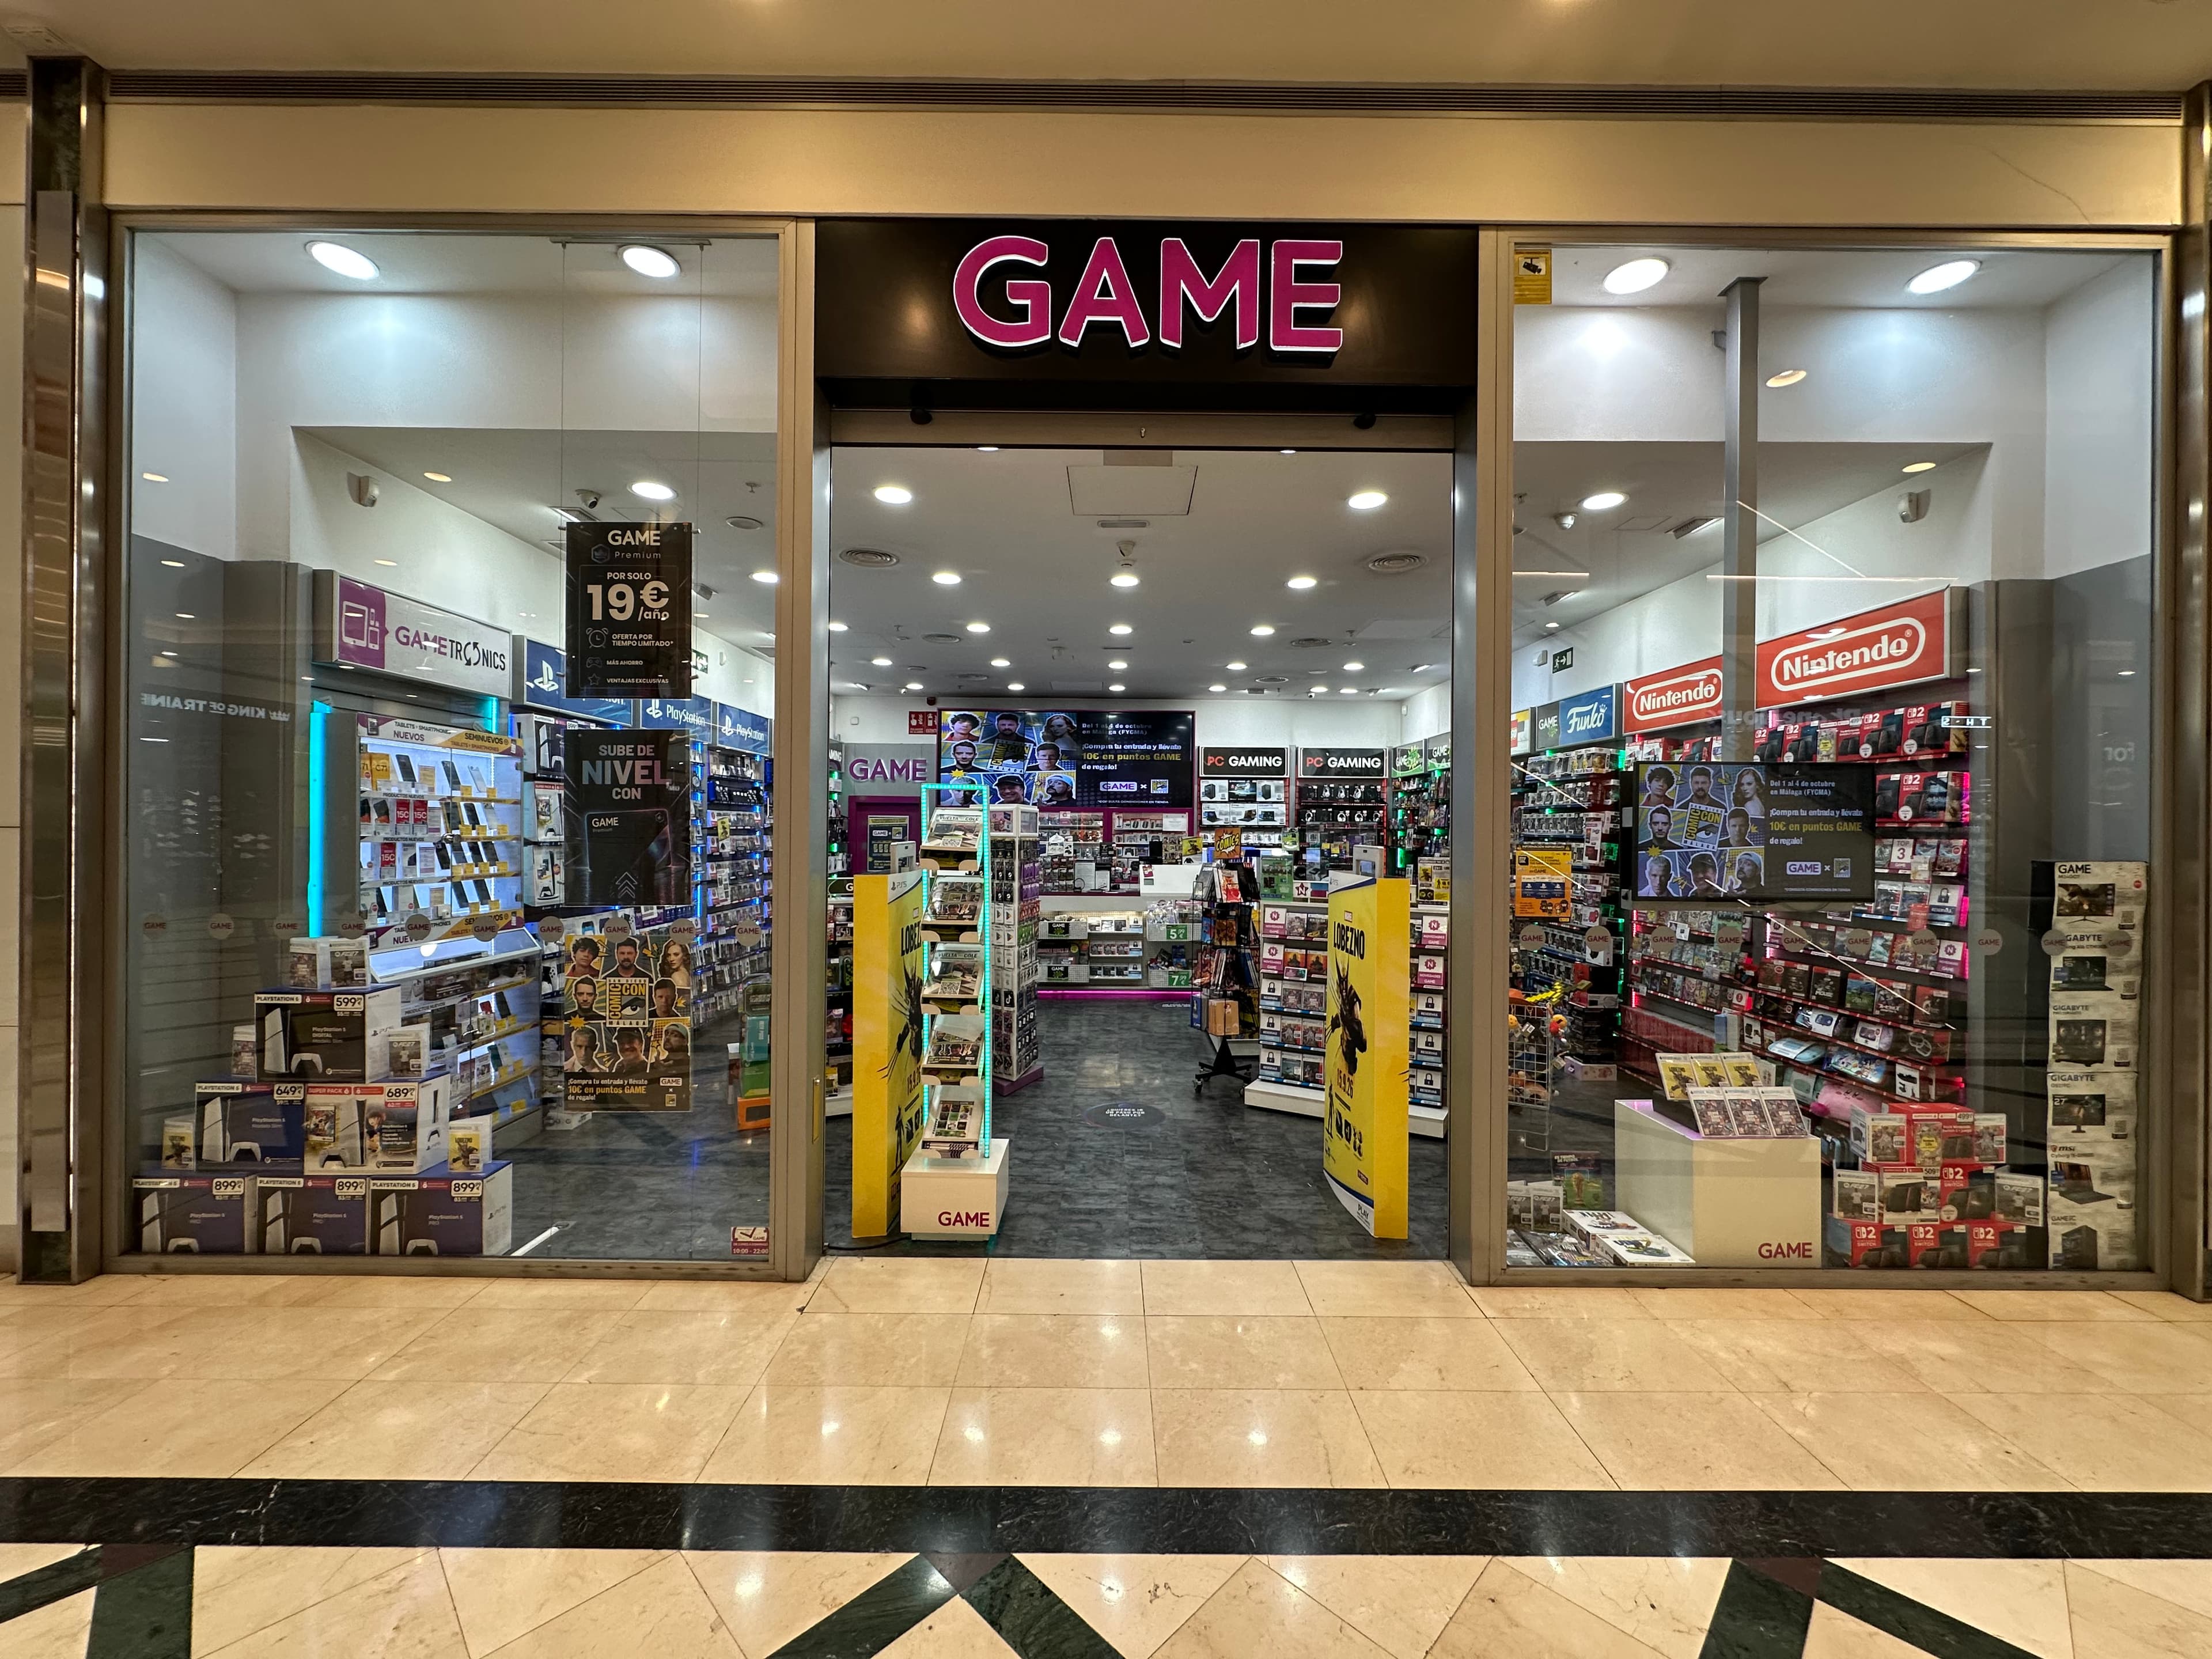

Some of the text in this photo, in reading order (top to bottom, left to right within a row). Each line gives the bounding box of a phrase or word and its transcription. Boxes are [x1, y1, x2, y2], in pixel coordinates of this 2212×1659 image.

[953, 235, 1343, 351] GAME
[608, 530, 661, 546] GAME
[627, 572, 652, 580] SOLO
[587, 584, 634, 621] 19
[1783, 635, 1908, 681] Nintendo
[1640, 681, 1715, 711] Nintendo
[666, 704, 706, 726] PlayStation
[1567, 702, 1605, 733] Funko
[1916, 707, 1925, 717] 2
[1539, 715, 1558, 730] GAME
[1873, 713, 1880, 723] 2
[395, 721, 415, 729] TABLETS
[393, 730, 425, 741] NUEVOS
[737, 724, 764, 740] PlayStation
[465, 733, 503, 745] SEMINUEVOS
[599, 745, 655, 756] SUBE DE
[1433, 745, 1447, 757] GAME
[1117, 753, 1150, 762] puntos
[1207, 756, 1282, 767] PC GAMING
[1306, 757, 1381, 768] PC GAMING
[1396, 753, 1408, 767] GAME
[582, 760, 672, 785] NIVEL
[849, 759, 927, 781] GAME
[1912, 775, 1921, 784] 2
[612, 787, 641, 800] CON
[1804, 789, 1831, 797] (FYCMA)
[592, 817, 619, 827] GAME
[1700, 811, 1721, 824] CON
[1685, 809, 1701, 839] COMIC
[1770, 822, 1786, 831] 10€
[1802, 822, 1834, 832] puntos
[1836, 822, 1862, 831] GAME
[1215, 834, 1240, 853] COMICS
[1780, 837, 1802, 846] regalo!
[1897, 848, 1906, 859] 3
[1789, 864, 1819, 873] GAME
[2058, 864, 2092, 874] GAME
[1170, 929, 1176, 940] 5
[1333, 921, 1365, 960] LOBEZNO
[1172, 975, 1179, 986] 7
[622, 984, 645, 995] CON
[336, 997, 357, 1007] 599
[609, 984, 622, 1019] COMIC
[2051, 1074, 2096, 1082] GIGABYTE
[1336, 1069, 1354, 1099] 15.9.26
[276, 1086, 297, 1095] 649
[387, 1088, 409, 1097] 689
[596, 1086, 622, 1094] puntos
[1955, 1168, 1964, 1179] 2
[214, 1181, 237, 1191] 899
[337, 1181, 358, 1191] 899
[453, 1183, 475, 1192] 899
[1358, 1203, 1369, 1219] PLAY
[938, 1211, 990, 1227] GAME
[1867, 1226, 1876, 1238] 2
[1925, 1226, 1934, 1238] 2
[1986, 1228, 1995, 1239] 2
[1758, 1242, 1812, 1259] GAME
